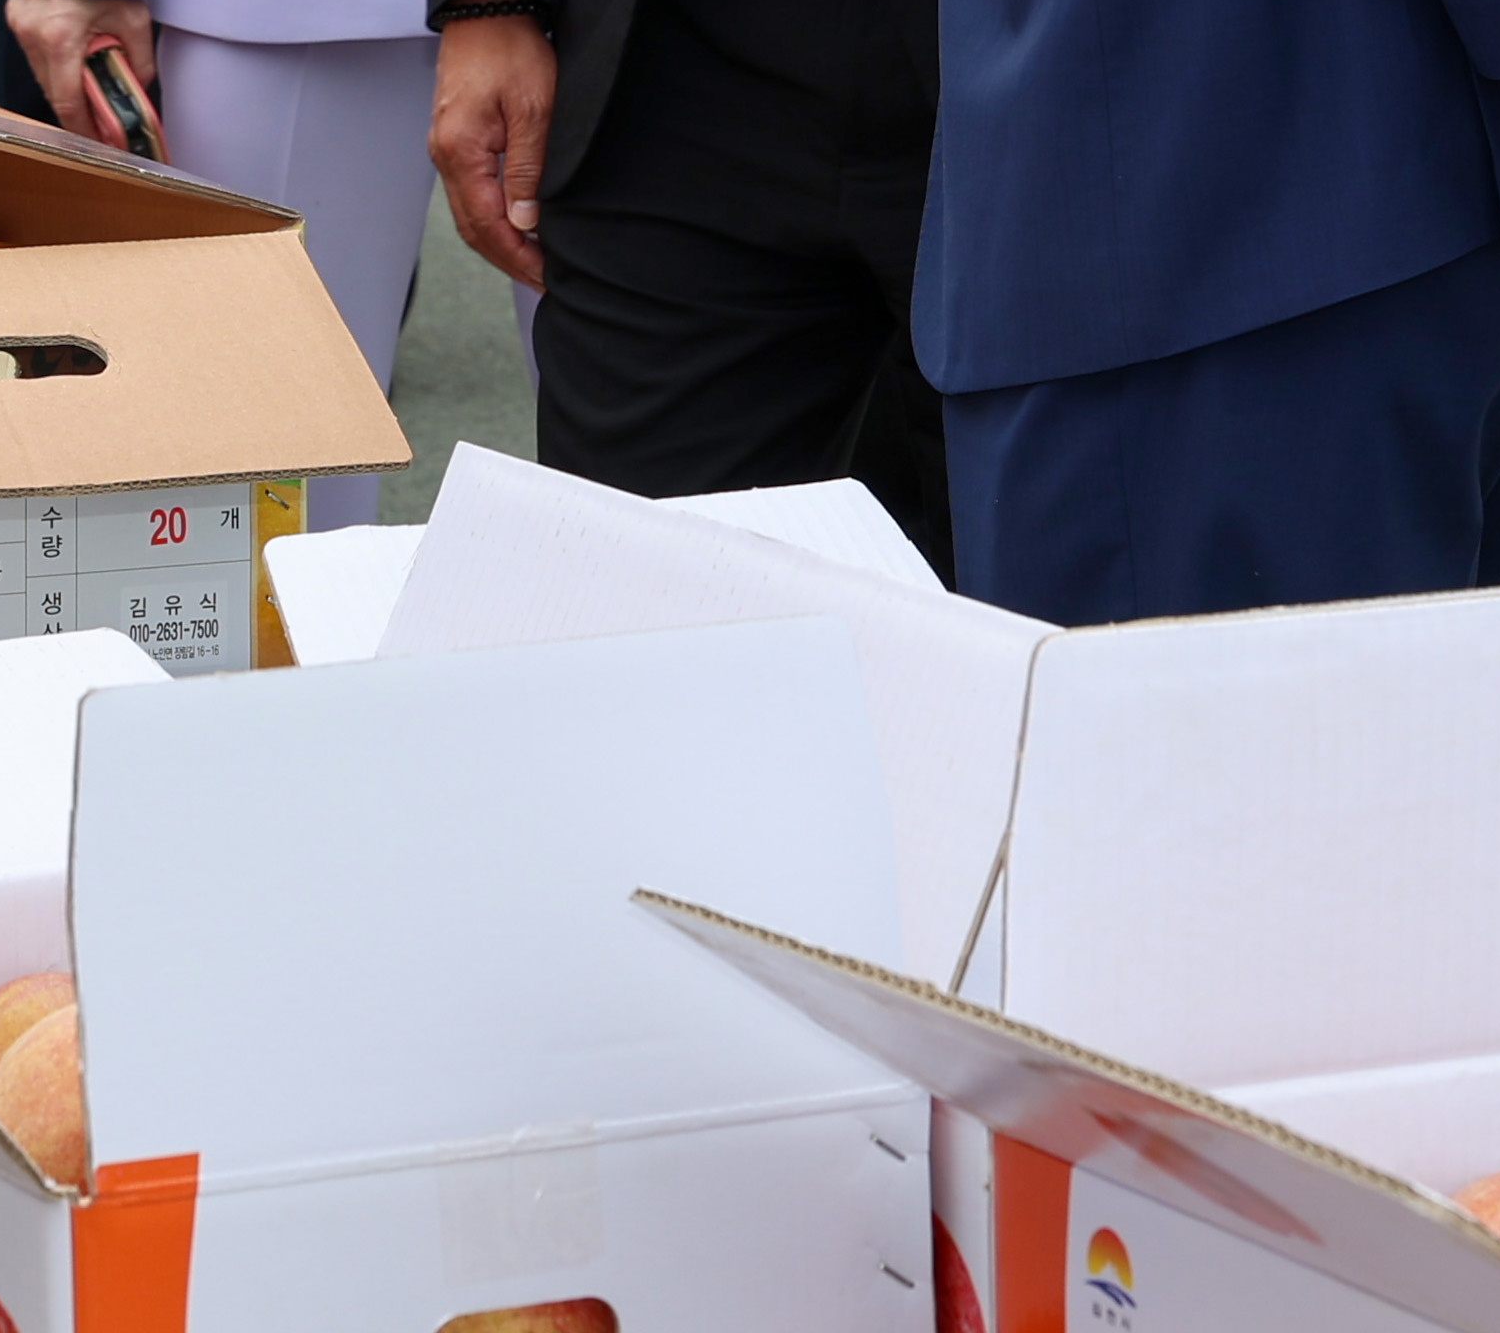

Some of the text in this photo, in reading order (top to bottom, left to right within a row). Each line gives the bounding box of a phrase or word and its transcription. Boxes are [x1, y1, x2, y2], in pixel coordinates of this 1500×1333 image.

[148, 505, 188, 548] 20
[219, 506, 242, 532] 개
[41, 505, 63, 561] 수량
[128, 618, 220, 644] 010-2631-7500
[196, 643, 221, 659] 16-16
